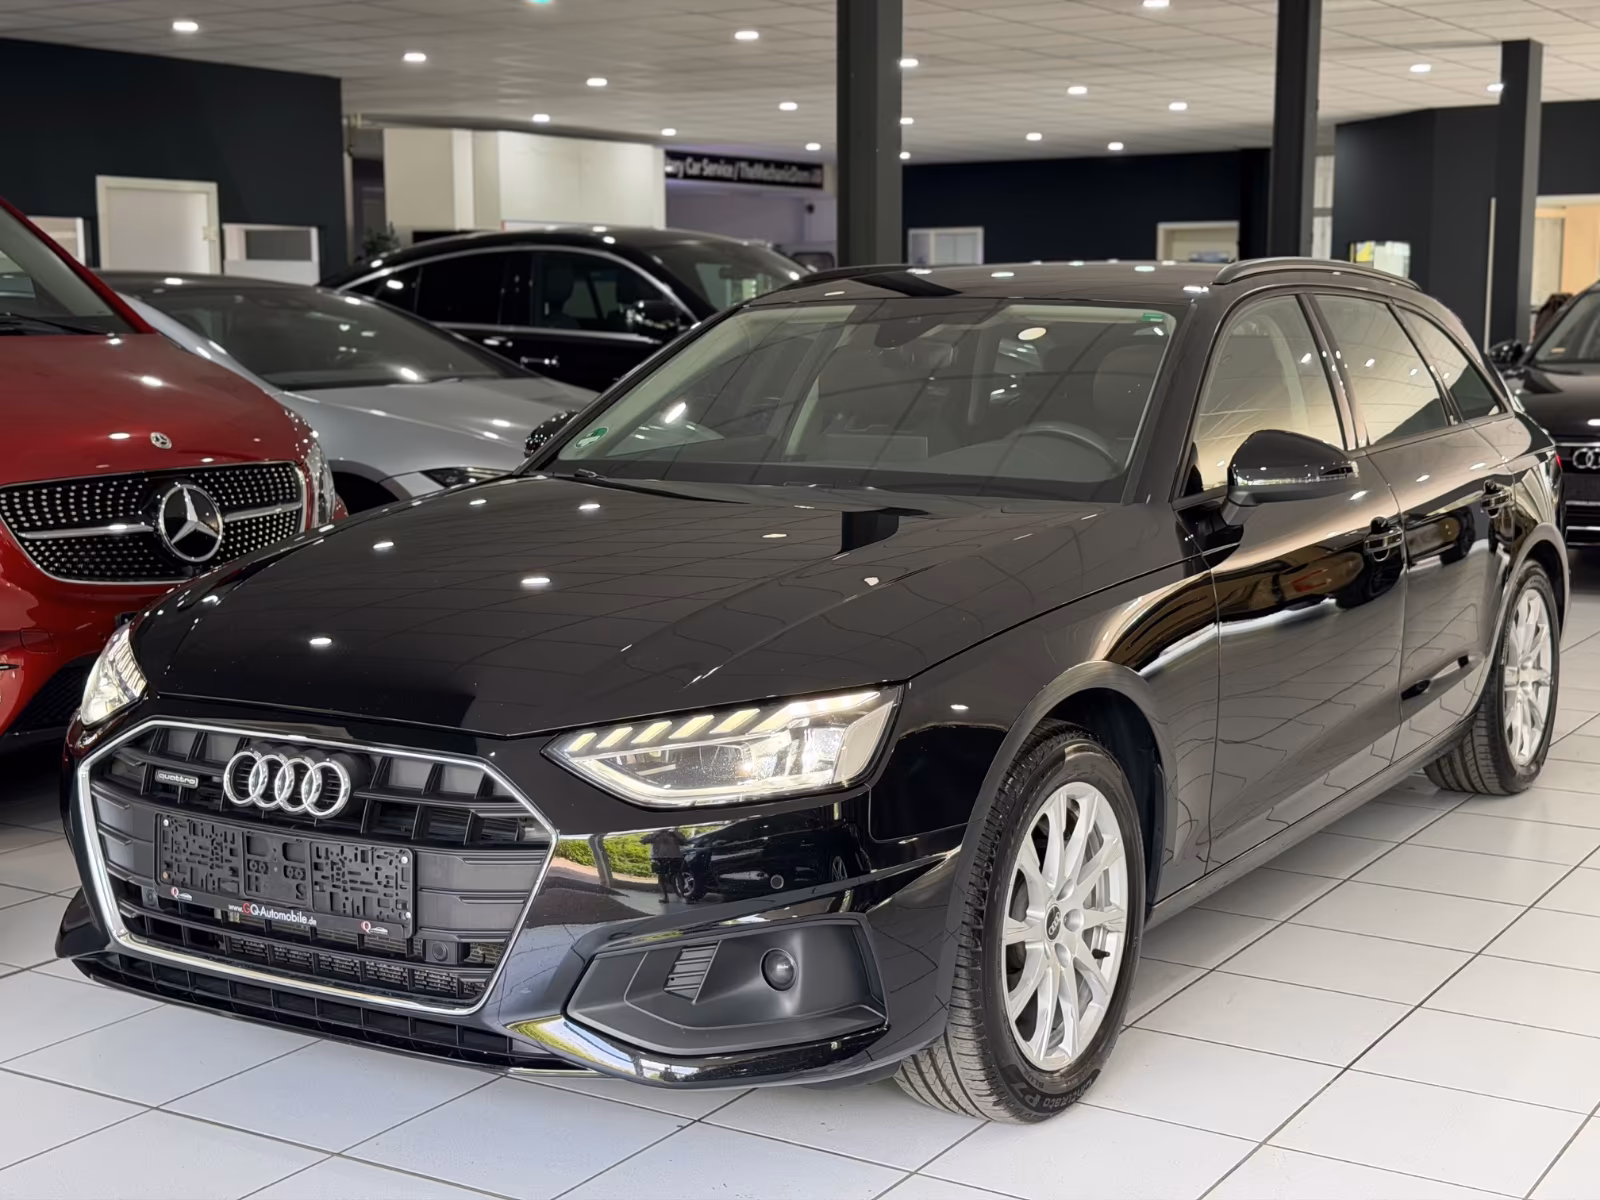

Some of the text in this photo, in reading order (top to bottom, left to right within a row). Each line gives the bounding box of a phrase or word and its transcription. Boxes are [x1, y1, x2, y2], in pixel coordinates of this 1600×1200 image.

[686, 157, 701, 175] Car
[702, 158, 734, 178] Service
[158, 773, 196, 785] quattro
[228, 903, 317, 926] www.GQ-Automobile.de
